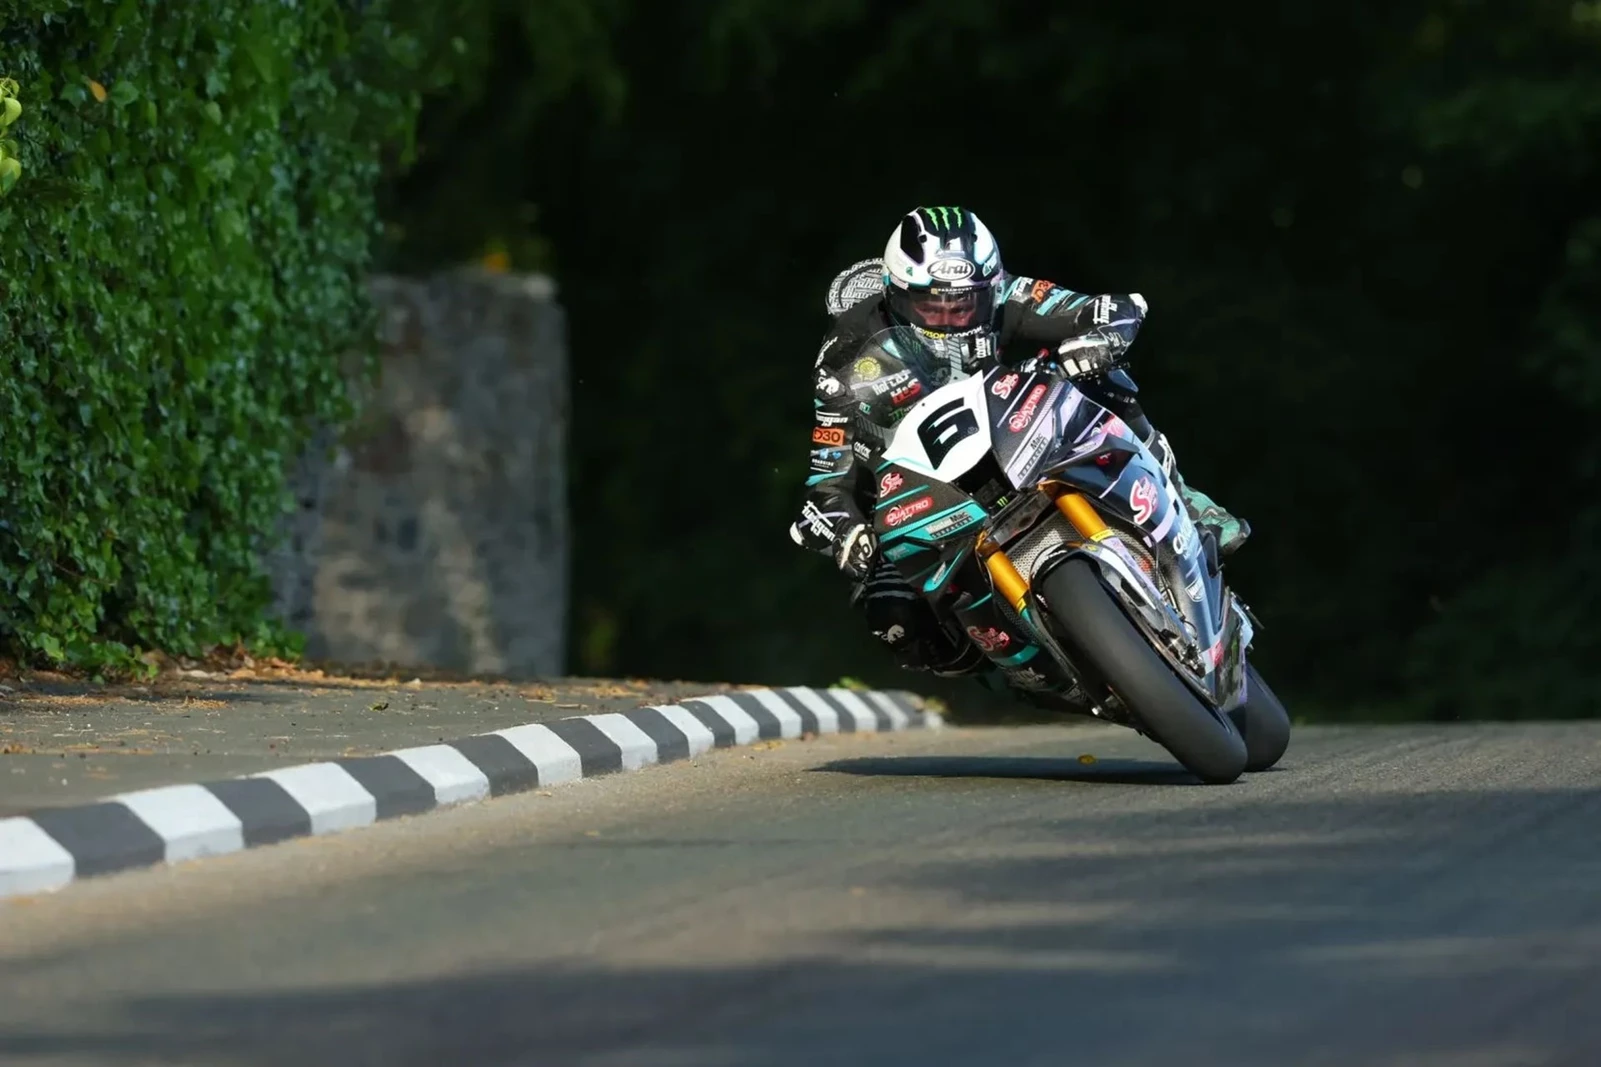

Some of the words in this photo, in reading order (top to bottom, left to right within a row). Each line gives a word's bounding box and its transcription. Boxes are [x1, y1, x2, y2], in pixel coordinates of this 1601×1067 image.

[934, 261, 969, 275] Arai
[1009, 388, 1042, 429] QUATTRO
[917, 396, 980, 470] 6
[886, 499, 929, 526] QUATTRO
